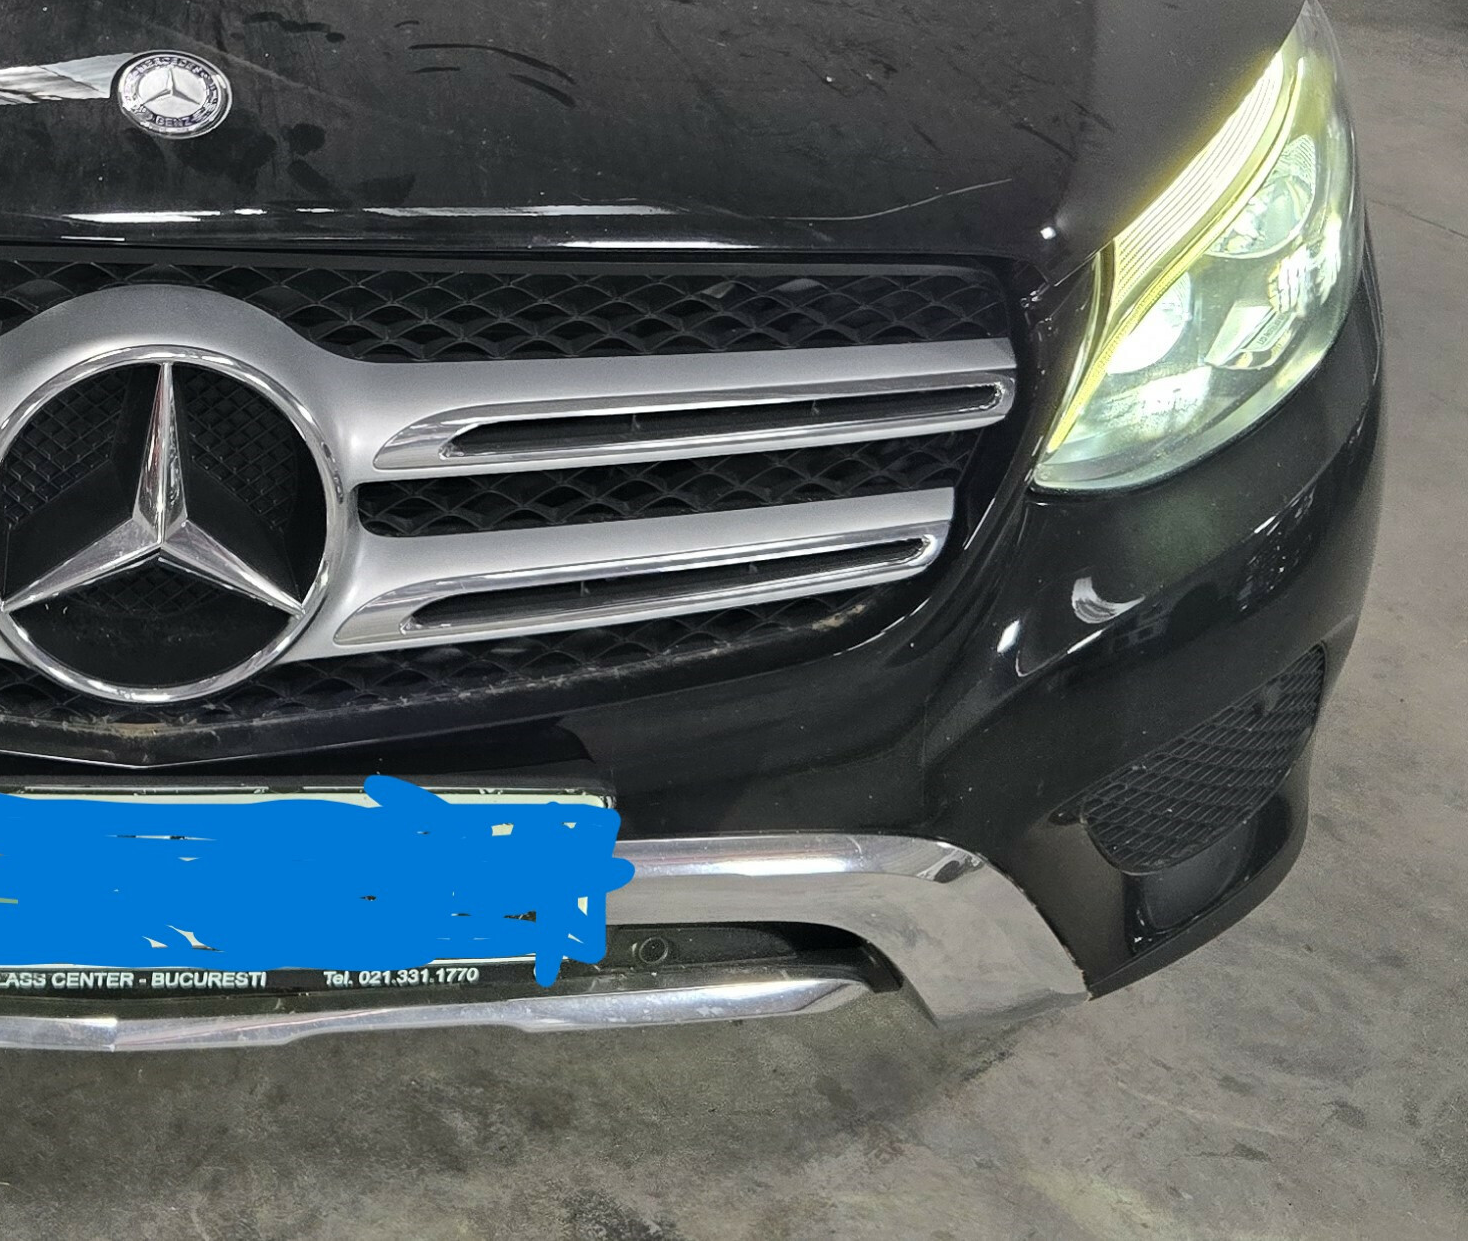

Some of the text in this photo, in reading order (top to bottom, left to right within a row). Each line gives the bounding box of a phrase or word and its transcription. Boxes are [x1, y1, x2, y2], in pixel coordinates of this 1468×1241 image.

[155, 115, 193, 127] BENZ
[51, 971, 134, 989] CENTER
[151, 970, 267, 989] BUCURESTI
[323, 967, 479, 987] Tel. 021.331.1770
